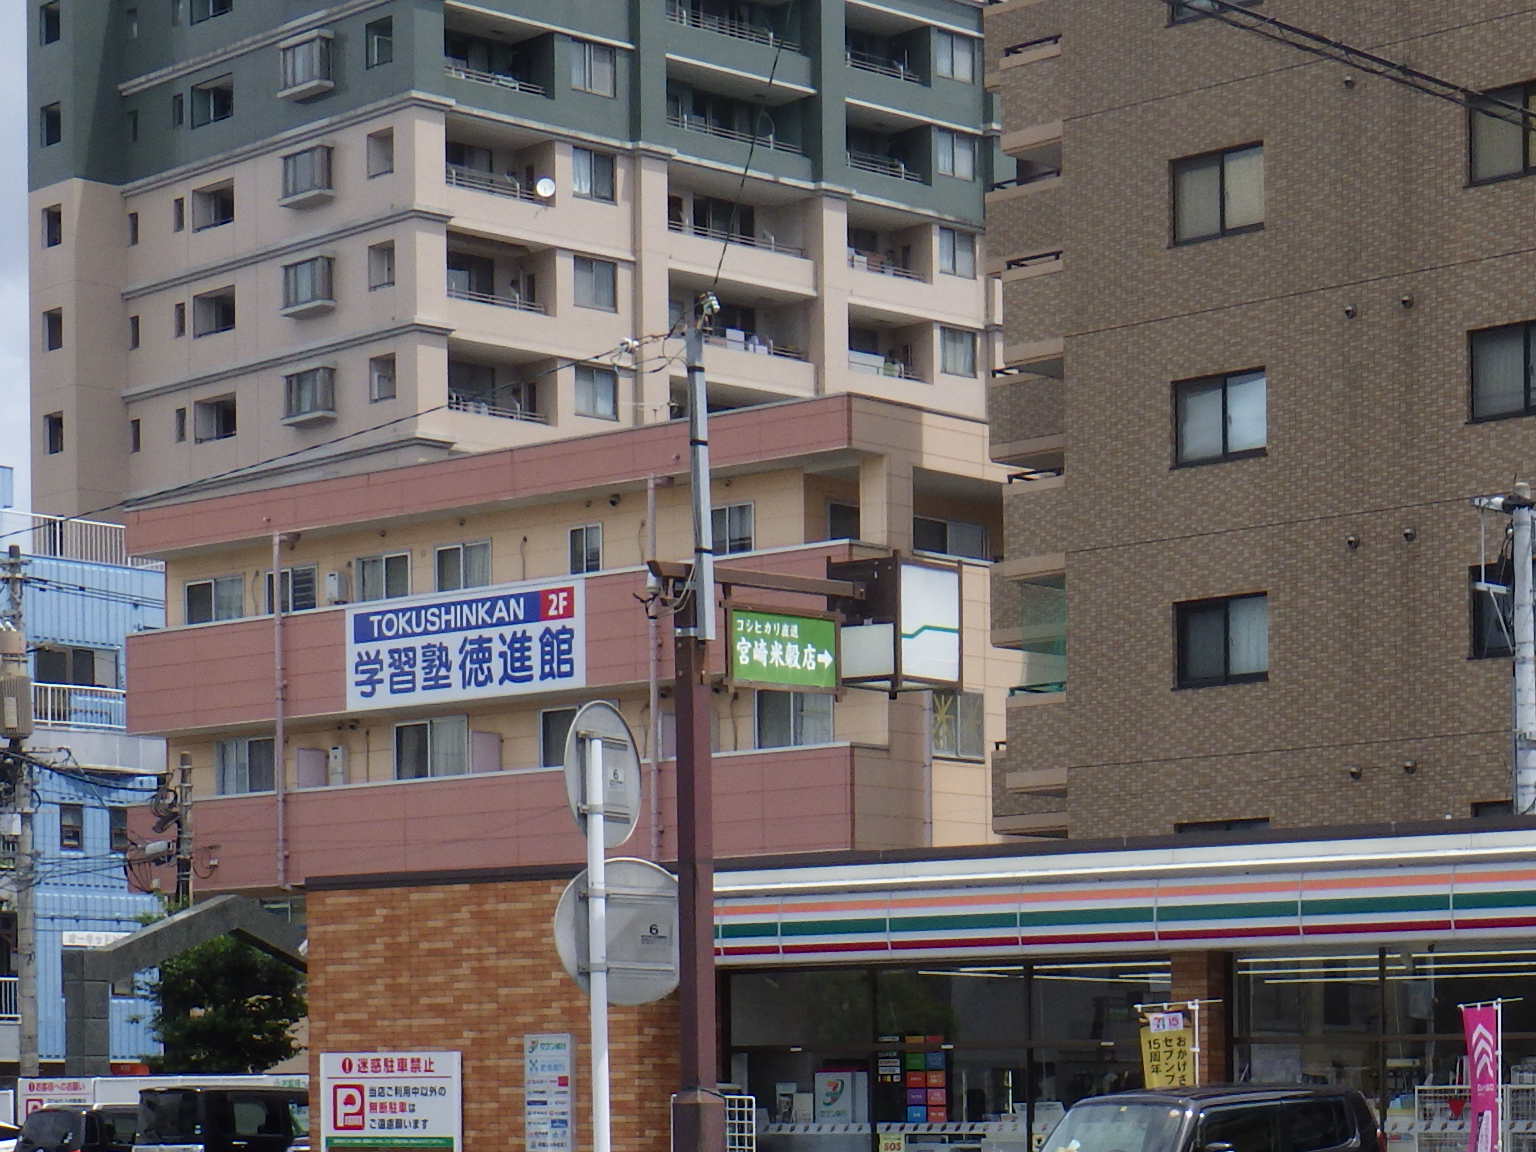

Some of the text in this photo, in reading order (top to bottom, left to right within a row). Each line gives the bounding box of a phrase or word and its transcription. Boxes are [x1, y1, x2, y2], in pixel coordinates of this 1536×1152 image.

[369, 592, 568, 638] TOKUSHINKAN 2F
[649, 923, 659, 936] 6
[357, 1056, 435, 1074] 迷惑駐車禁止
[368, 1086, 447, 1098] 当店ご利用中以外の
[369, 1101, 416, 1114] 無断駐車は
